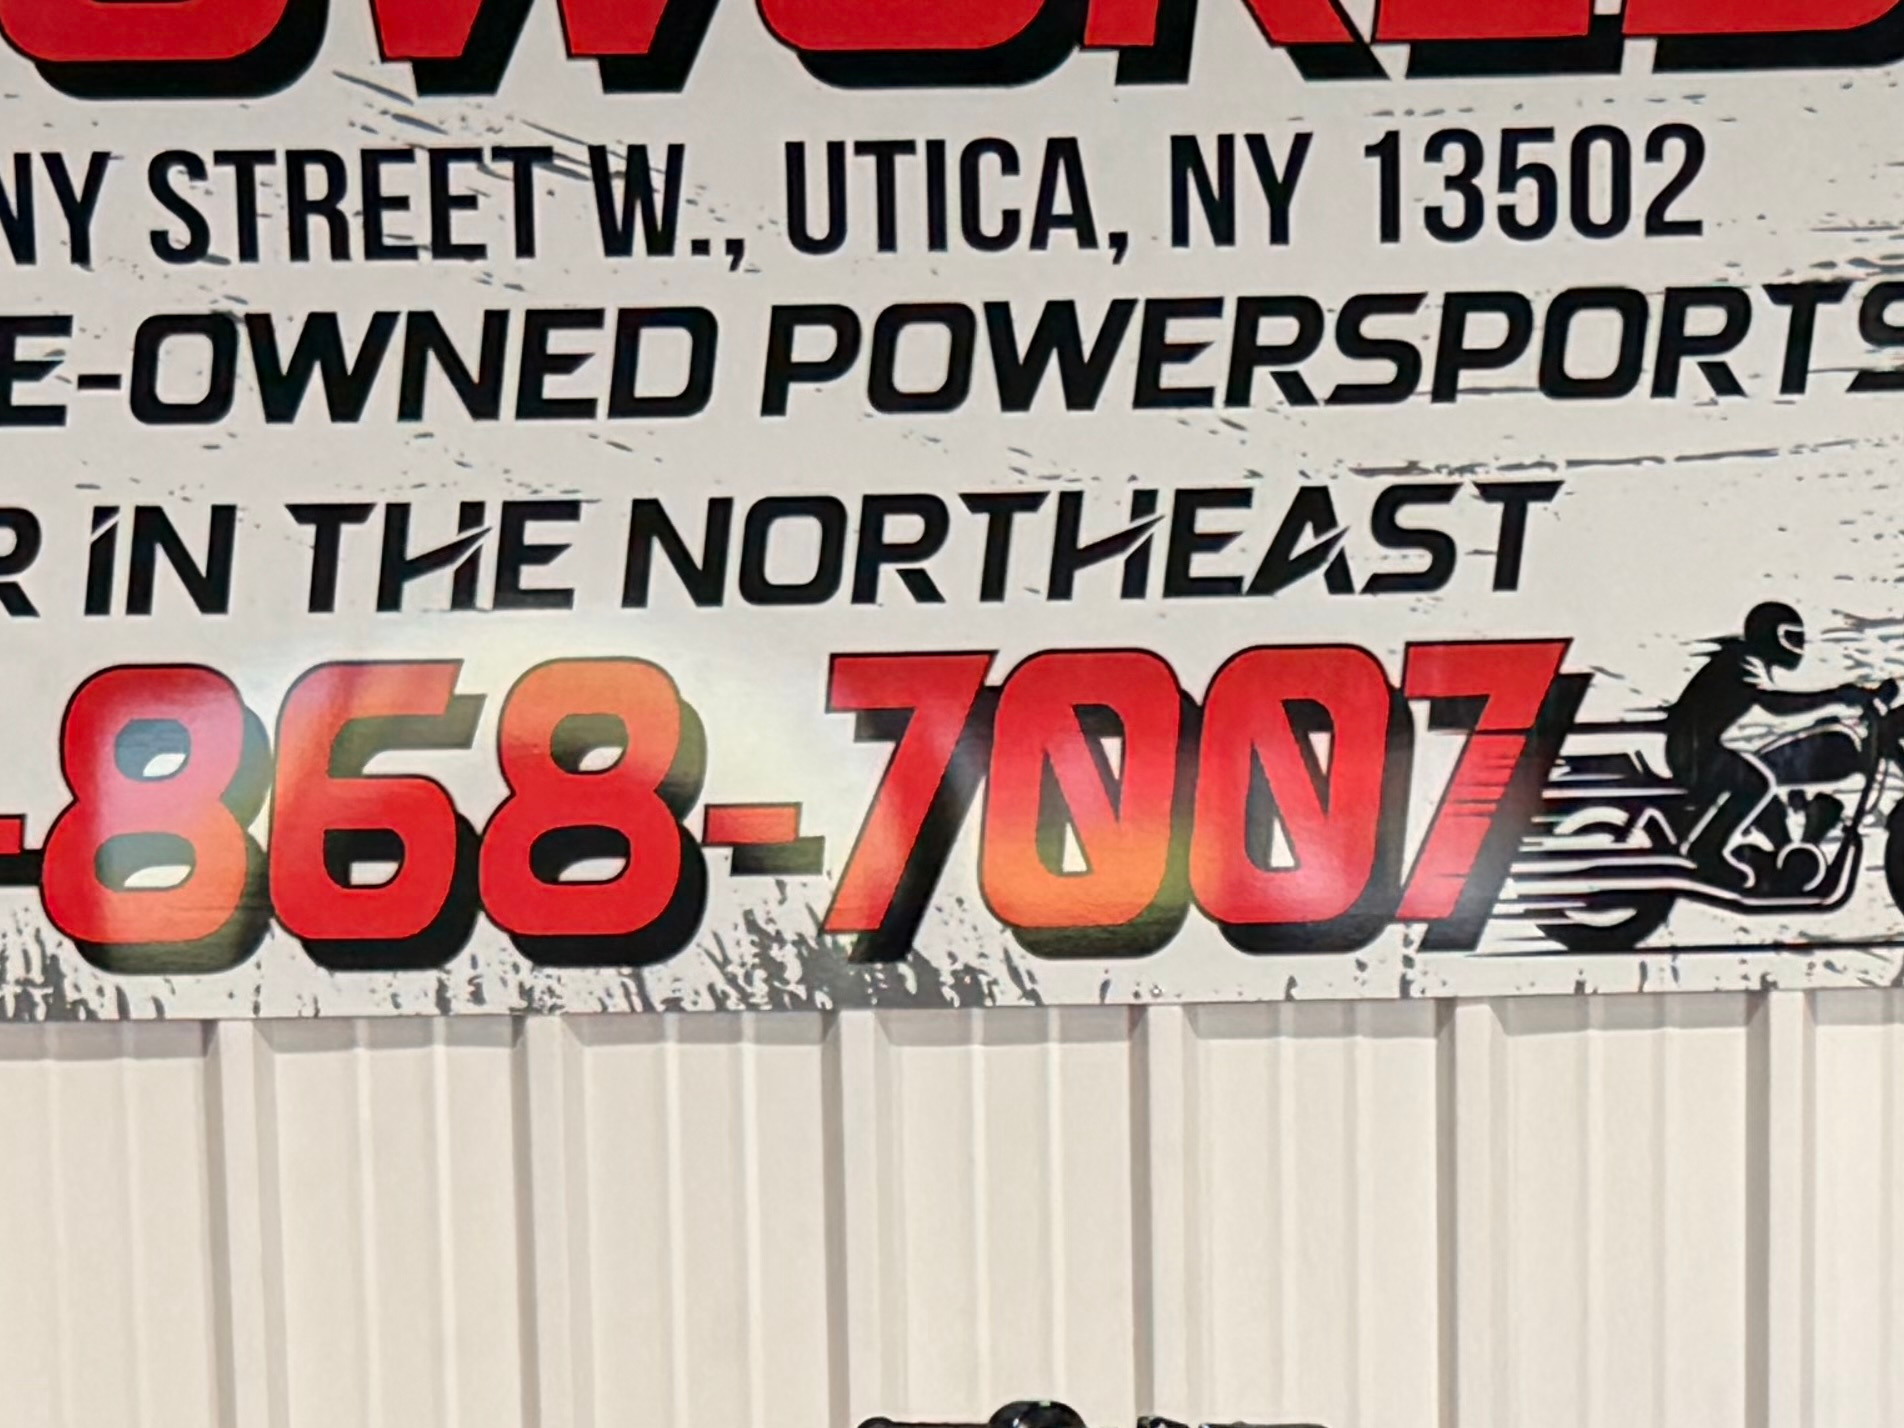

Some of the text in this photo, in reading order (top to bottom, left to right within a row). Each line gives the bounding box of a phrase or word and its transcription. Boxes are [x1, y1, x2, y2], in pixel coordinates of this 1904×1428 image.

[148, 145, 566, 264] STREET
[585, 143, 745, 272] W.,
[785, 137, 1128, 264] UTICA,
[1170, 132, 1314, 248] NY
[1364, 123, 1705, 243] 13502
[85, 504, 237, 615] IN
[285, 499, 581, 613] THE
[622, 480, 1563, 607] NORTHEAST
